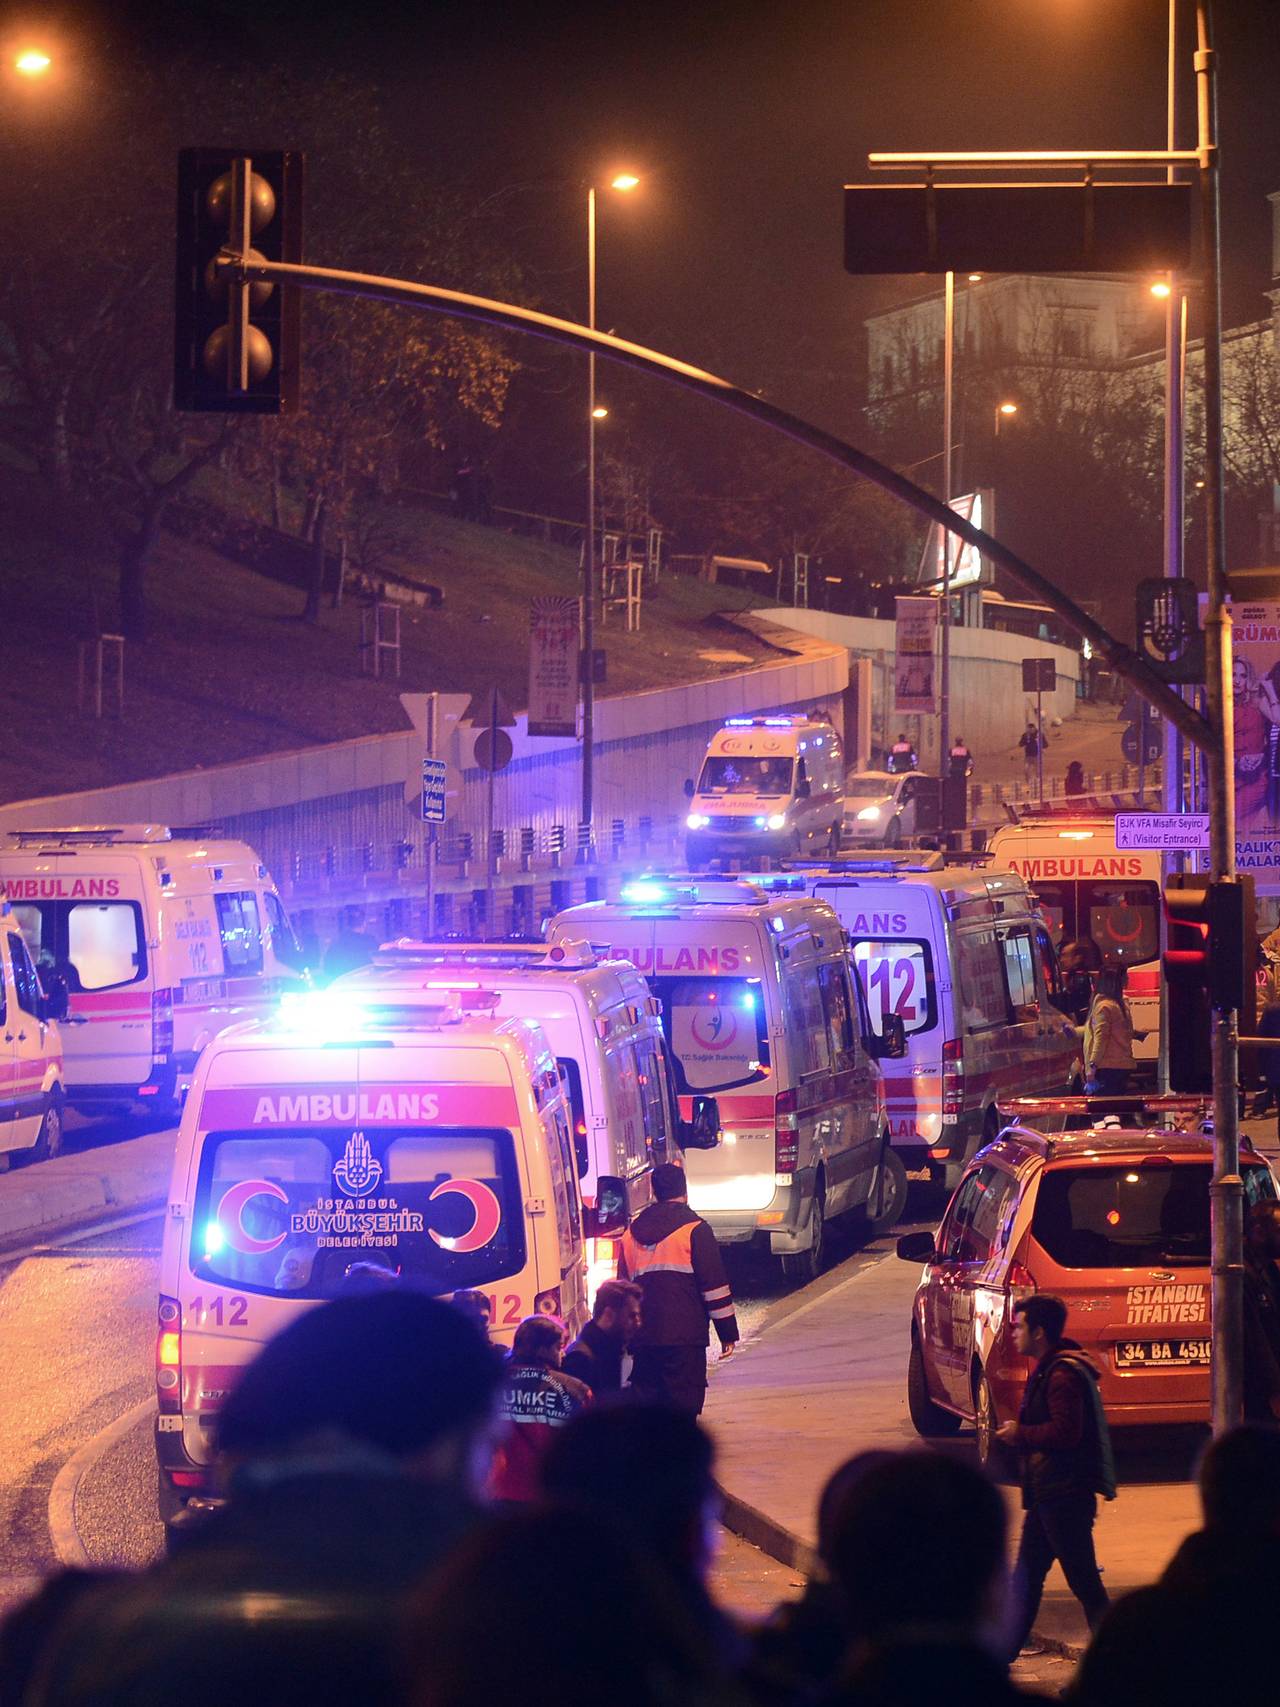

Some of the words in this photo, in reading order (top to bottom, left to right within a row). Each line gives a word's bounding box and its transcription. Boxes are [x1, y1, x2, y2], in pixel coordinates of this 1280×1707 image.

[1120, 818, 1135, 828] BJK
[1137, 818, 1151, 828] VFA
[1153, 818, 1178, 828] Misafir
[1178, 818, 1204, 830] Seyirci
[1133, 834, 1161, 845] (Visitor
[1163, 833, 1202, 845] Entrance)
[253, 1093, 440, 1124] AMBULANS
[317, 1197, 398, 1210] İSTANBUL
[291, 1208, 424, 1238] BÜYÜKŞEHİR
[317, 1234, 398, 1248] BELEDİYESİ
[1126, 1285, 1206, 1305] İSTANBUL
[189, 1296, 249, 1327] 112
[489, 1294, 523, 1325] 12
[1127, 1303, 1206, 1324] İTFAİYESİ
[1125, 1343, 1145, 1360] 34
[1151, 1342, 1172, 1359] BA
[503, 1389, 557, 1409] UMKE
